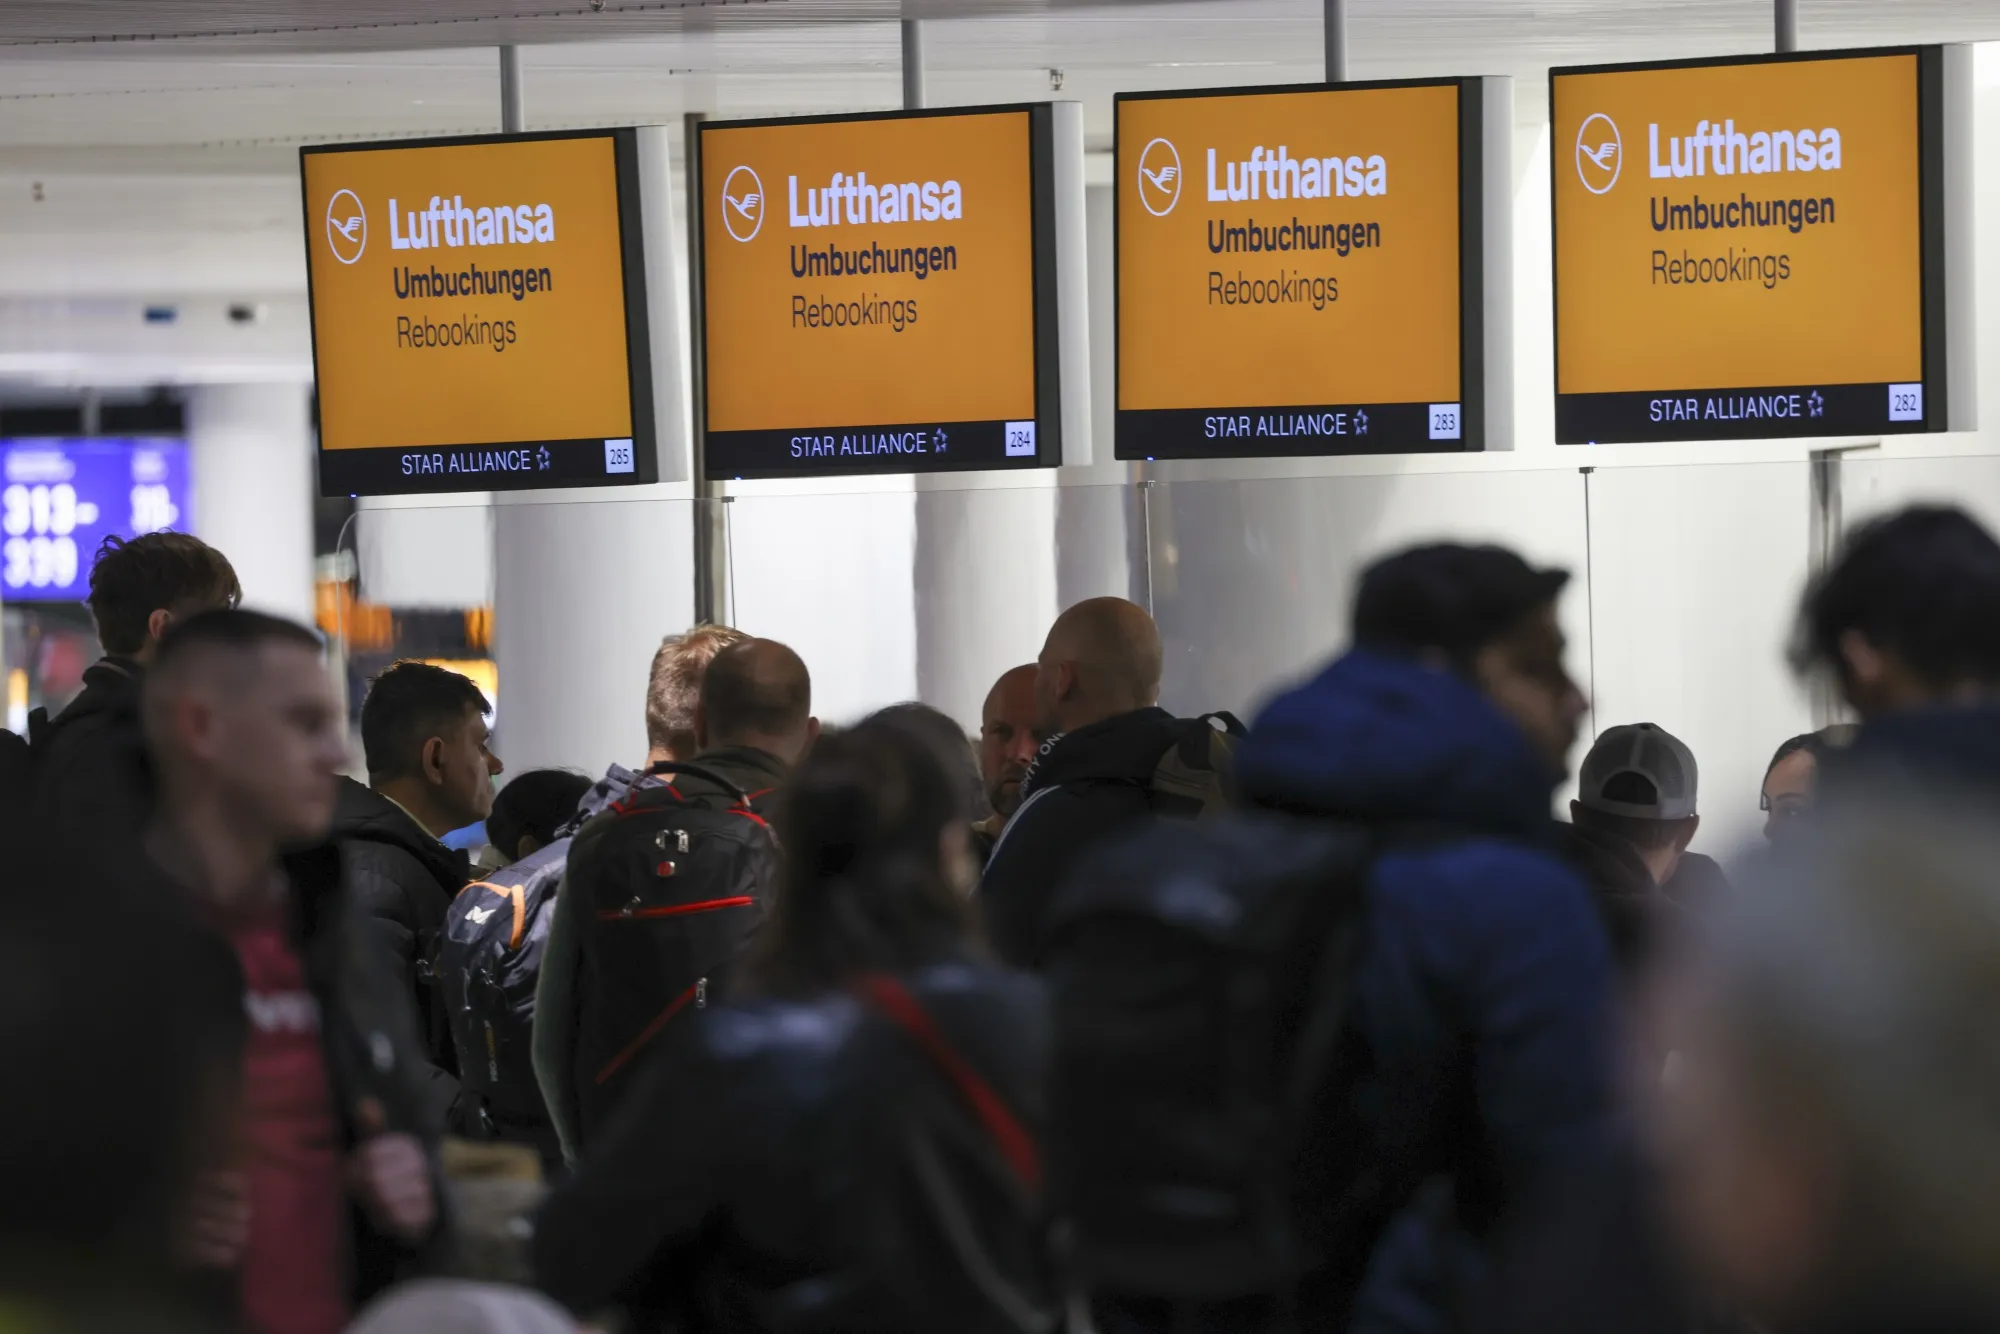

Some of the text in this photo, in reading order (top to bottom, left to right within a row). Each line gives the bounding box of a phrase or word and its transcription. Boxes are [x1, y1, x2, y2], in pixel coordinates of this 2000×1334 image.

[1648, 118, 1842, 179] Lufthansa
[1206, 145, 1387, 202] Lufthansa
[788, 171, 963, 228] Lufthansa
[1650, 192, 1835, 234] Umbuchungen
[388, 195, 555, 250] Lufthansa
[1207, 216, 1381, 258] Umbuchungen
[790, 241, 957, 280] Umbuchungen
[1652, 246, 1790, 290] Rebookings
[393, 263, 552, 302] Umbuchungen
[1208, 269, 1338, 311] Rebookings
[792, 292, 917, 333] Rebookings
[397, 313, 516, 353] Rebookings
[1433, 412, 1456, 432] 283
[1649, 394, 1802, 423] STAR ALLIANCE
[1893, 393, 1918, 413] 282
[790, 431, 928, 458] STAR ALLIANCE
[1009, 430, 1032, 449] 284
[1204, 412, 1348, 439] STAR ALLIANCE
[401, 449, 532, 476] STAR ALLIANCE
[609, 447, 630, 466] 285
